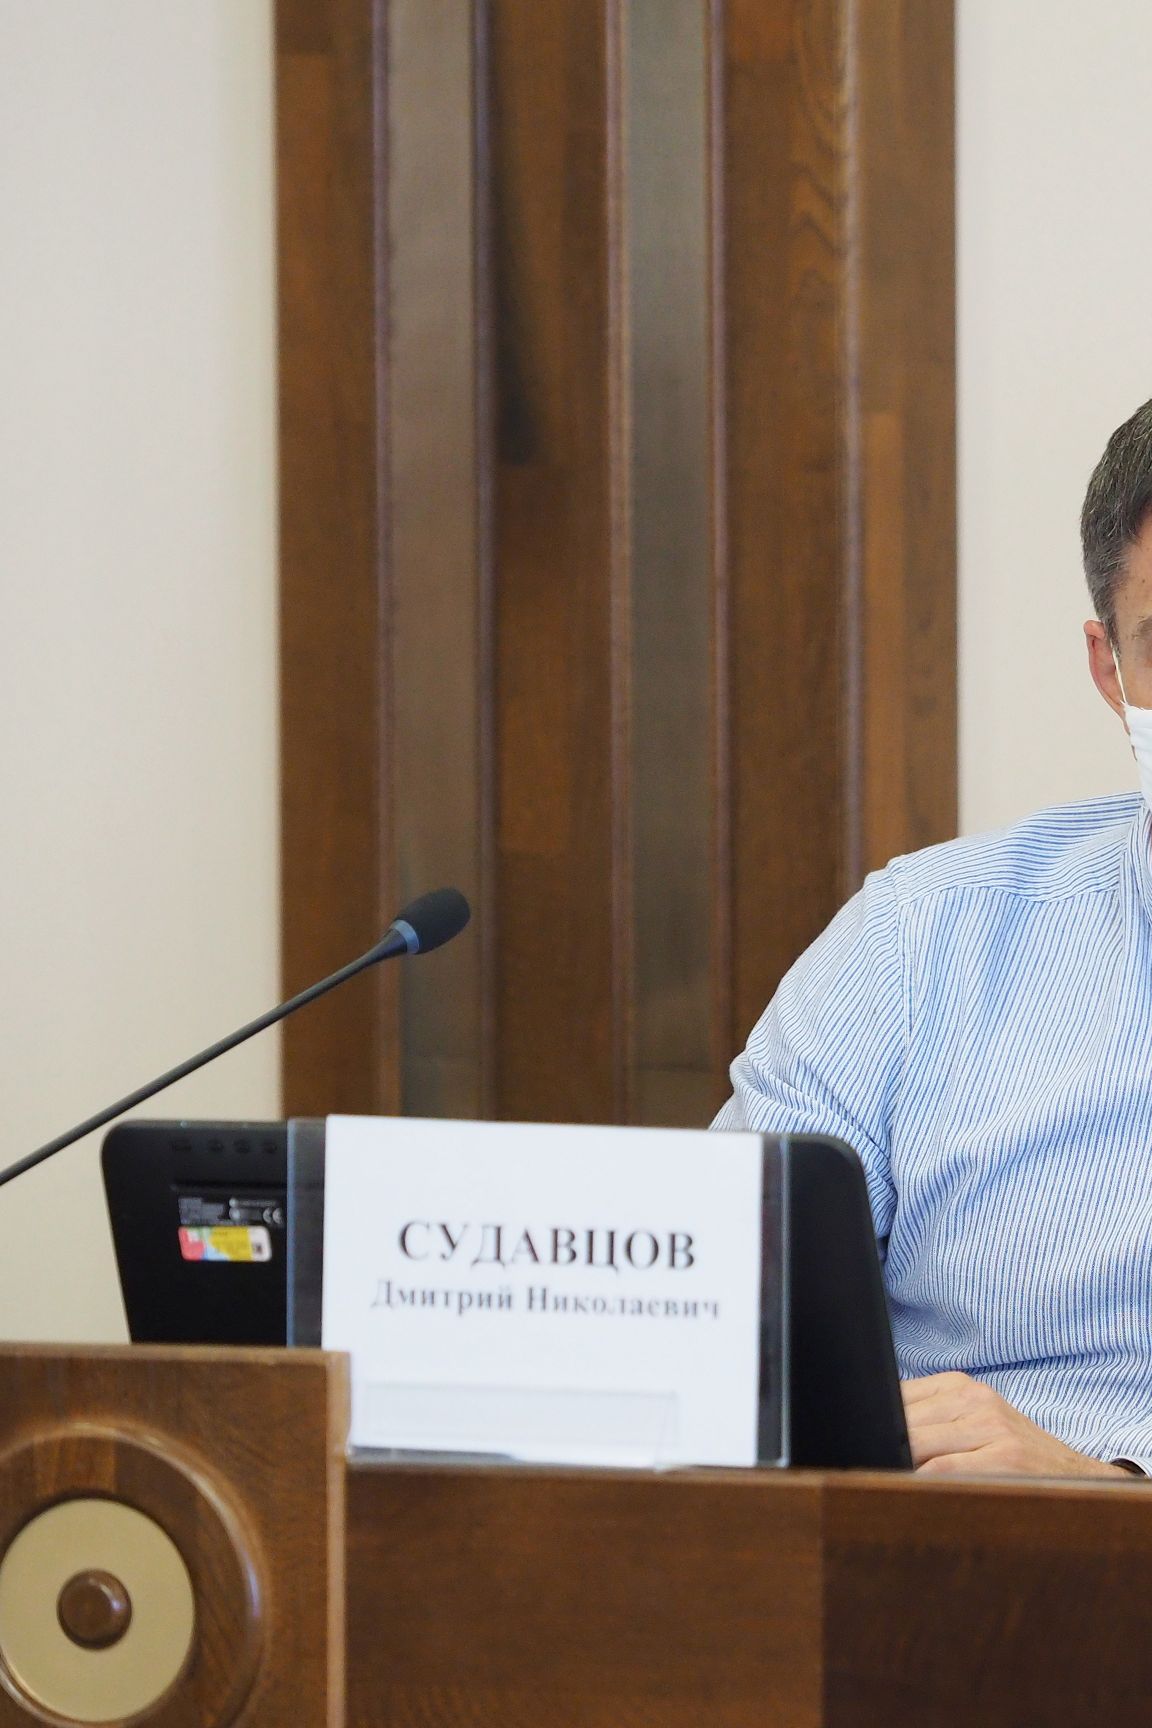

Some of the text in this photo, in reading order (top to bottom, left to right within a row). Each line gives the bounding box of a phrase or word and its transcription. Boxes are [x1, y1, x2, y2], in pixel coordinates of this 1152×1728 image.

[399, 1220, 696, 1272] СУДАВЦОВ
[371, 1279, 720, 1320] Дмитрий Николаевич
